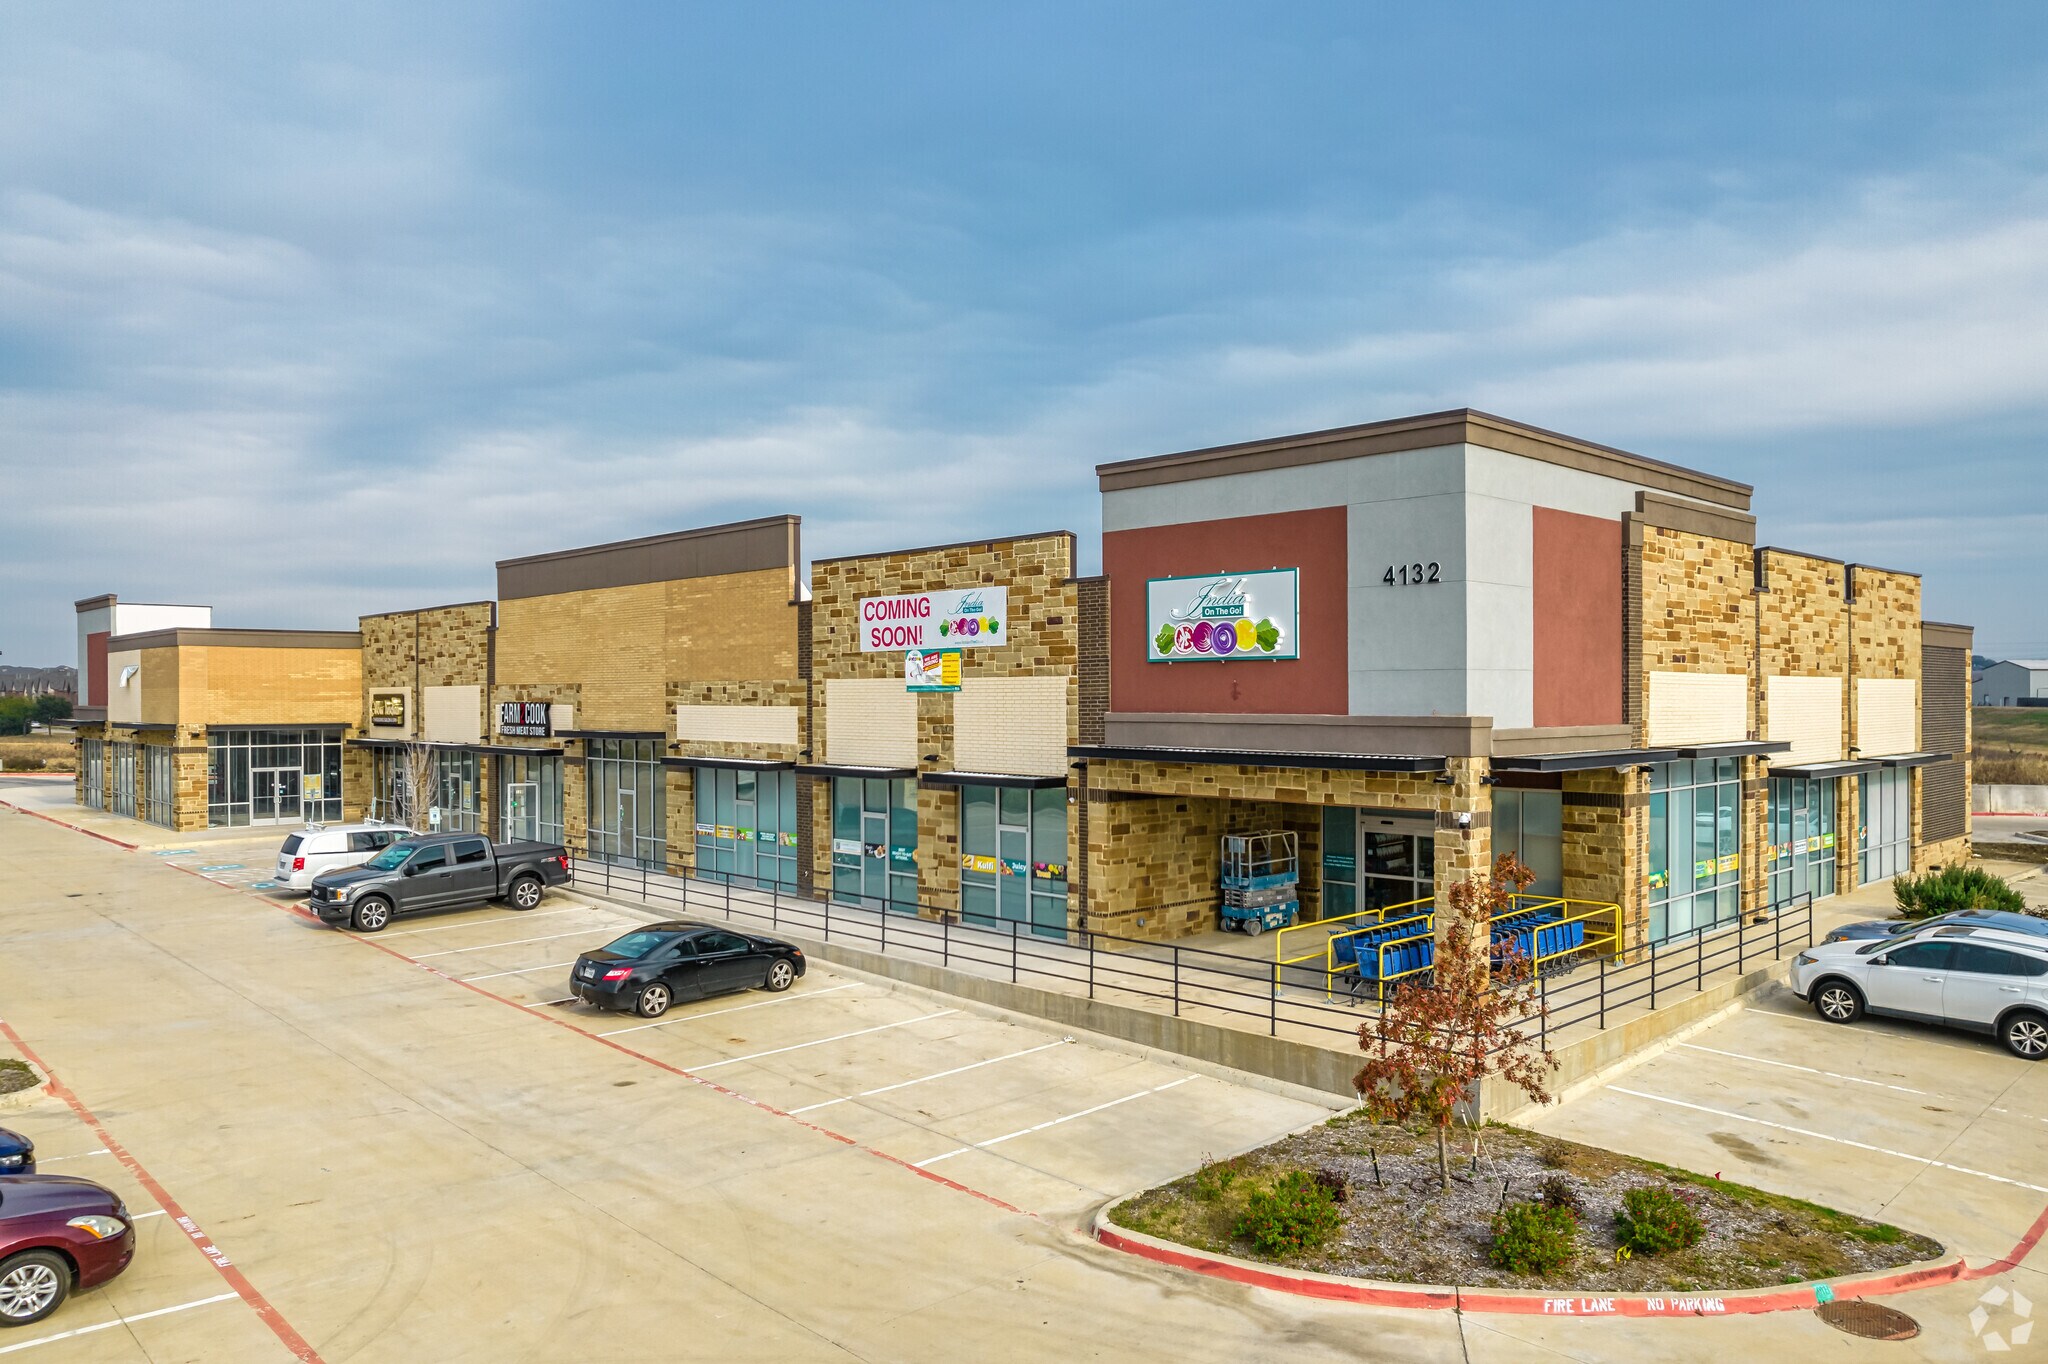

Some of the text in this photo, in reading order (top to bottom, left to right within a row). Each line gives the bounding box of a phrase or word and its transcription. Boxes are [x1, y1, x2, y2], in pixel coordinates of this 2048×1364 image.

[1383, 562, 1441, 586] 4132
[947, 591, 984, 615] India
[1170, 578, 1246, 619] India
[864, 597, 930, 621] COMING
[1204, 606, 1242, 616] On The Go!
[871, 625, 923, 648] SOON!
[501, 726, 546, 736] FRESH MEAT STORE
[977, 860, 994, 870] Kulfi
[1012, 862, 1027, 872] Juicy
[1544, 1298, 1726, 1313] FIRE LANE NO PARKING
